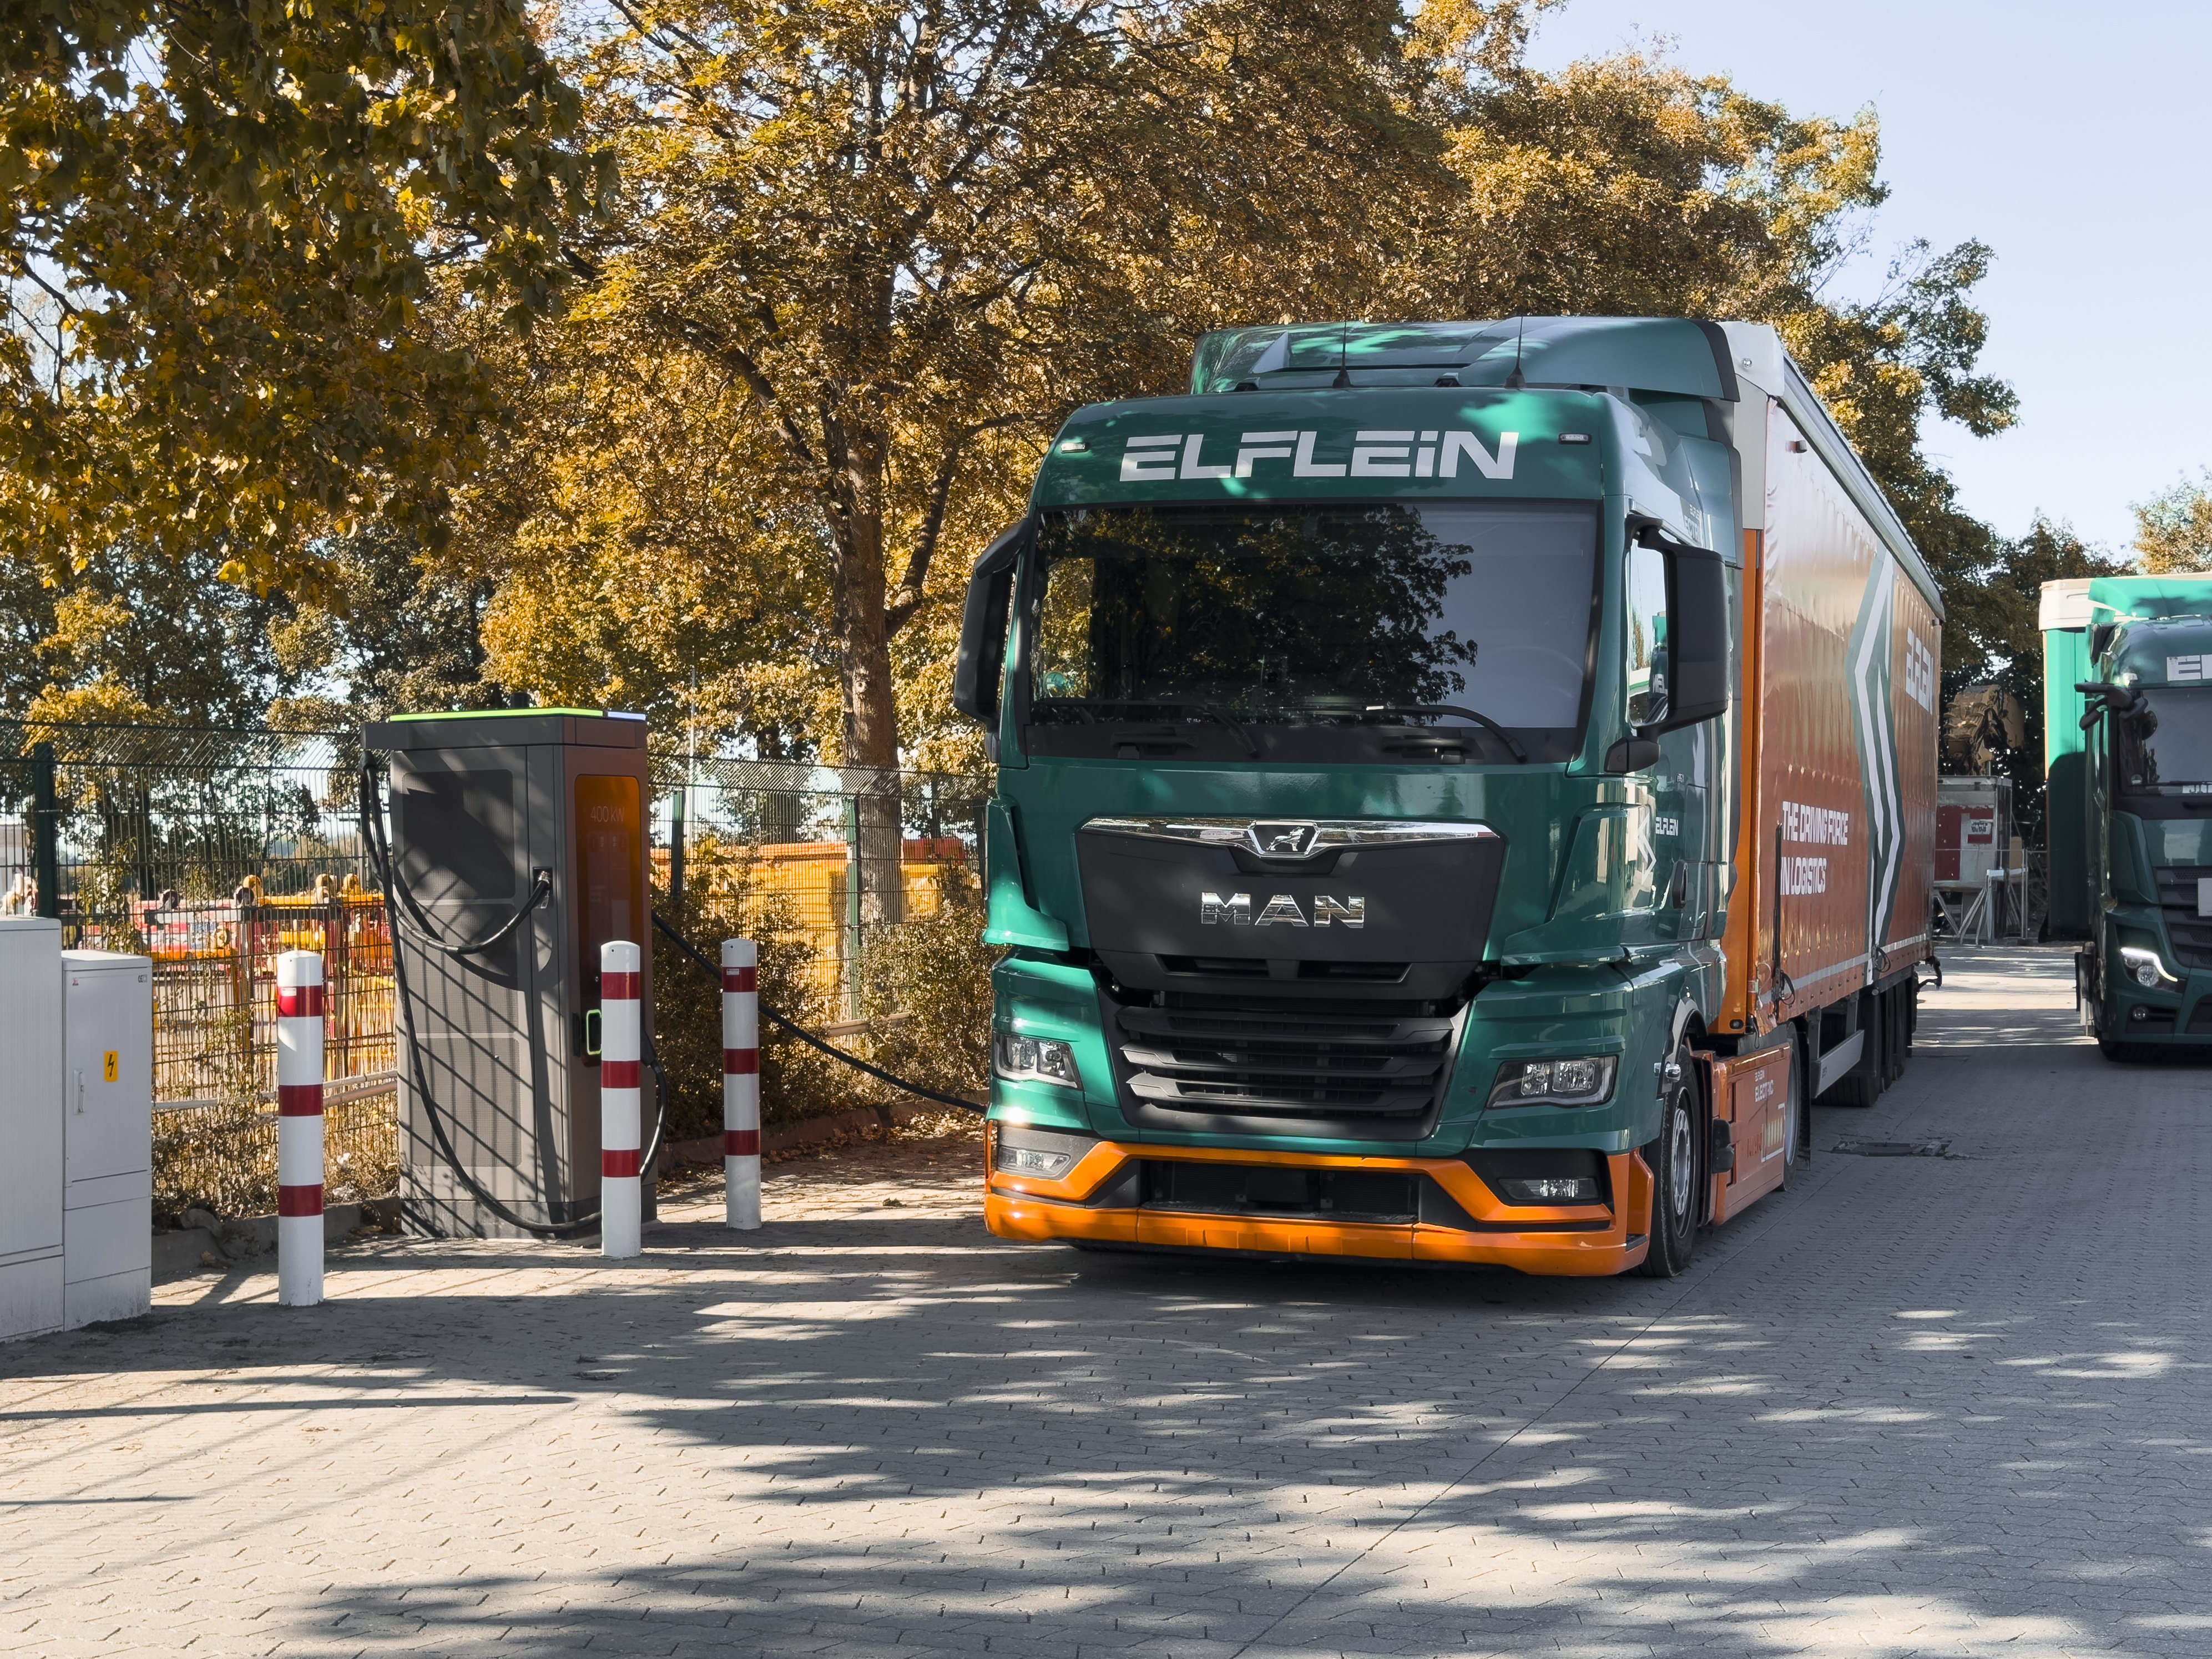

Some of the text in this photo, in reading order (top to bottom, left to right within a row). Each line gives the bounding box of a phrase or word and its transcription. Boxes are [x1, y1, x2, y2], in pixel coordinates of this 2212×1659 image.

[590, 805, 625, 822] 400 kW
[1782, 801, 1849, 846] THE DRIVING FORCE
[1780, 857, 1827, 896] IN LOGISTICS
[1200, 891, 1366, 929] MAN
